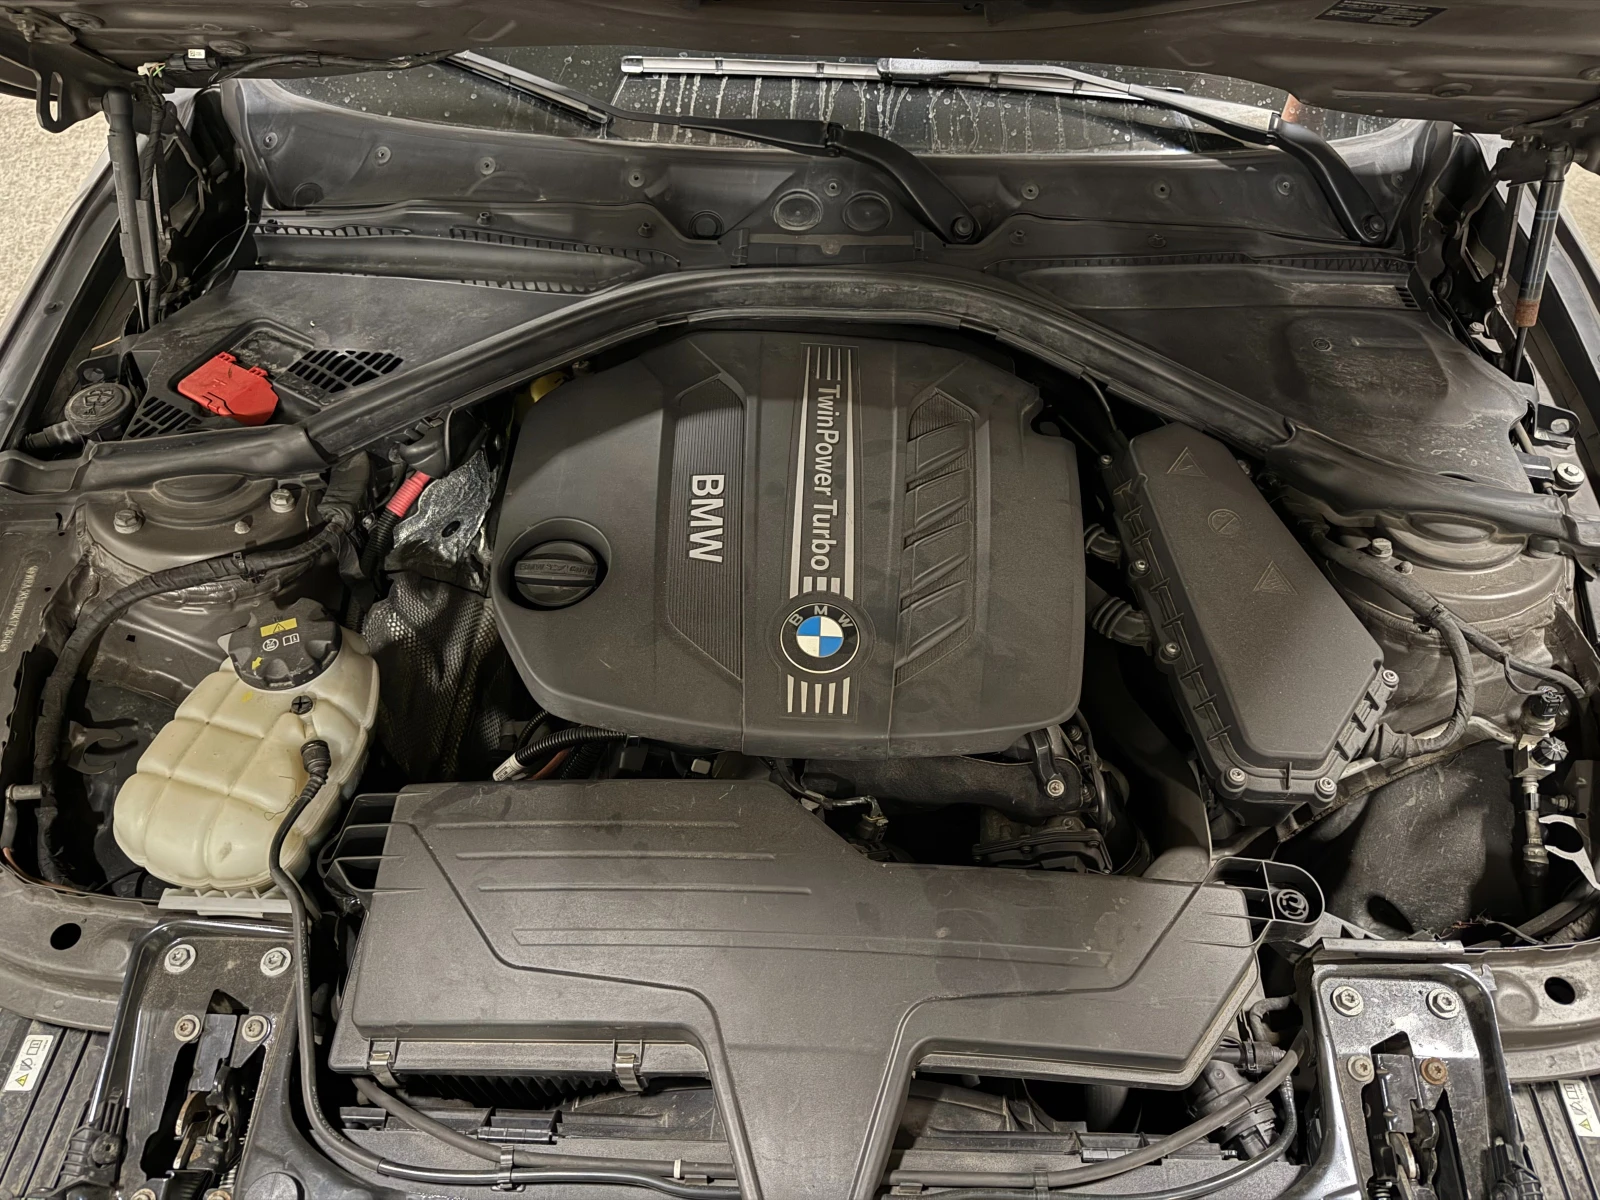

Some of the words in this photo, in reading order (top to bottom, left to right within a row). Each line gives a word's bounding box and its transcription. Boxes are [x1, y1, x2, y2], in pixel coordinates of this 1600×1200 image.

[814, 385, 840, 496] TwinPower
[689, 474, 725, 562] BMW
[811, 500, 838, 571] Turbo
[789, 605, 853, 628] BMW
